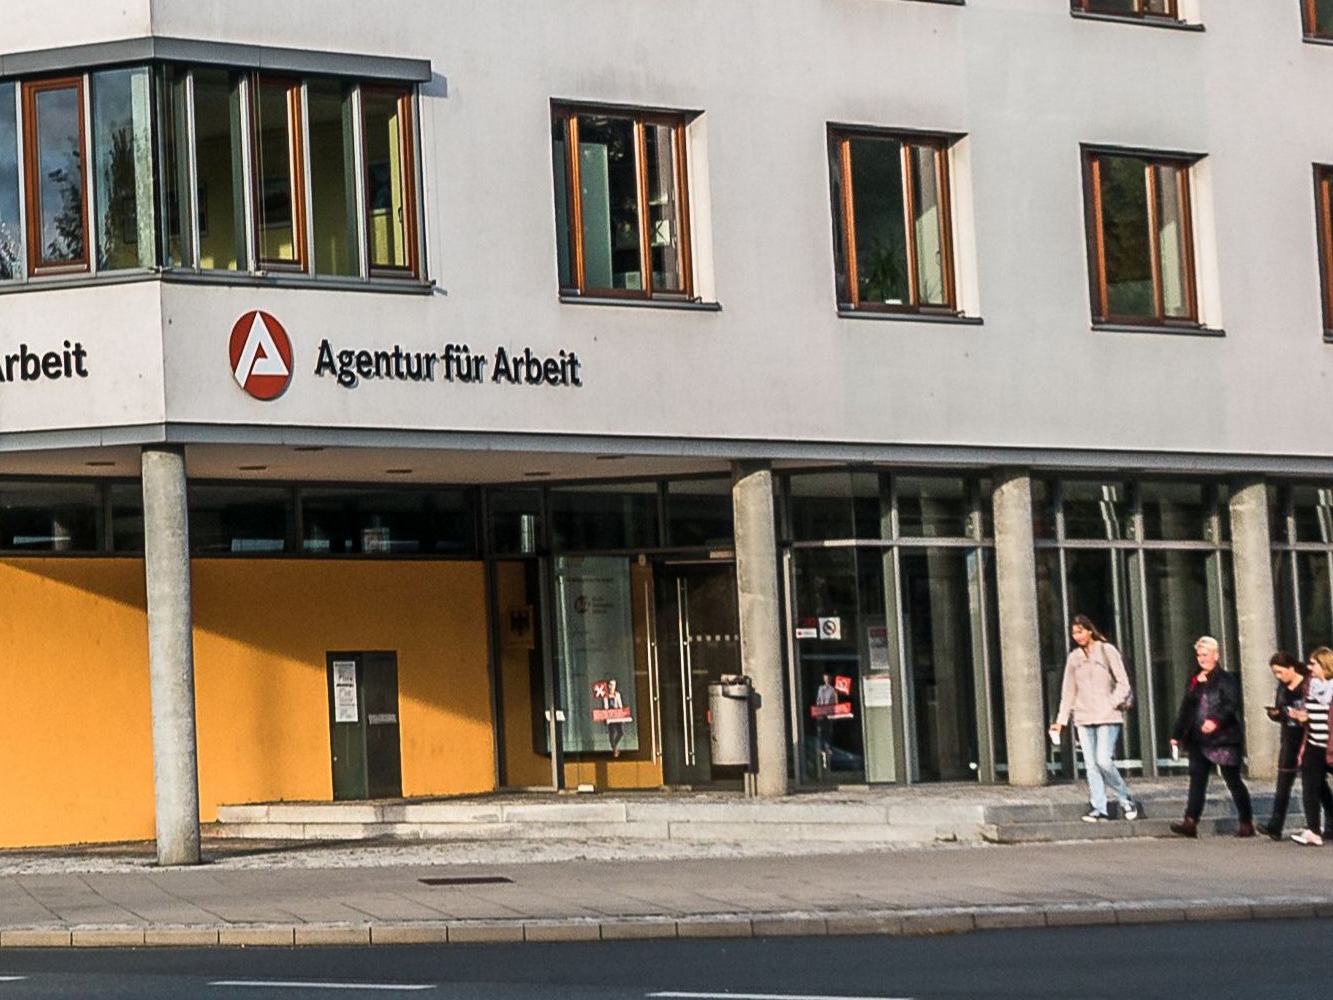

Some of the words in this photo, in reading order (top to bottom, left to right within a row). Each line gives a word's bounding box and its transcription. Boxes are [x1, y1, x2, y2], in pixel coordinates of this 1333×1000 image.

[314, 339, 438, 386] Agentur
[443, 344, 485, 382] für
[492, 346, 582, 386] Arbeit
